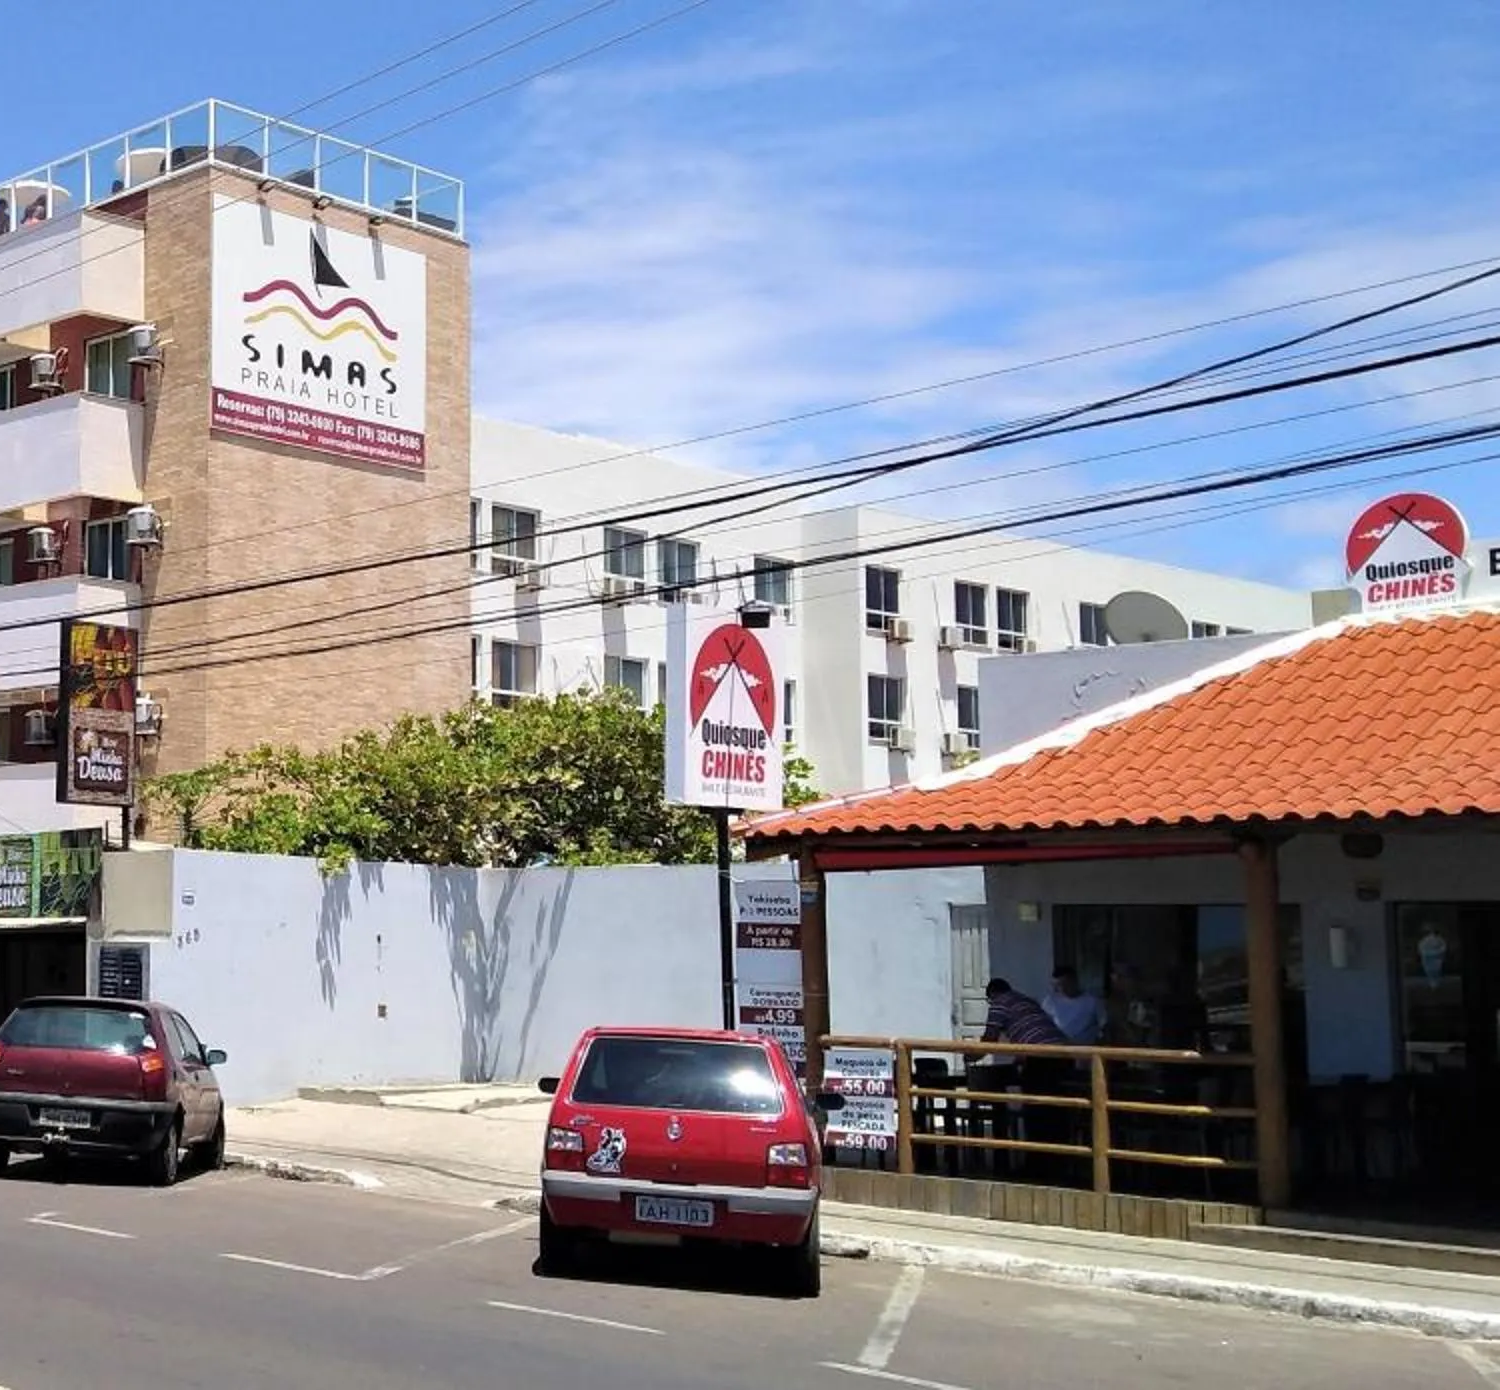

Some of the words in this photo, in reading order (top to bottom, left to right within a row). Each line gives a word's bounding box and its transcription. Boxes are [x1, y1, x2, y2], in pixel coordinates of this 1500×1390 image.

[241, 334, 398, 395] SIMAS
[241, 367, 311, 399] PRAIA
[327, 388, 400, 418] HOTEL
[1366, 555, 1454, 582] Quiosque
[1367, 572, 1456, 603] CHINÊS
[702, 718, 766, 750] Quiosque
[77, 755, 123, 782] Deusa
[702, 749, 766, 783] CHINÊS
[756, 907, 798, 917] PESSOAS
